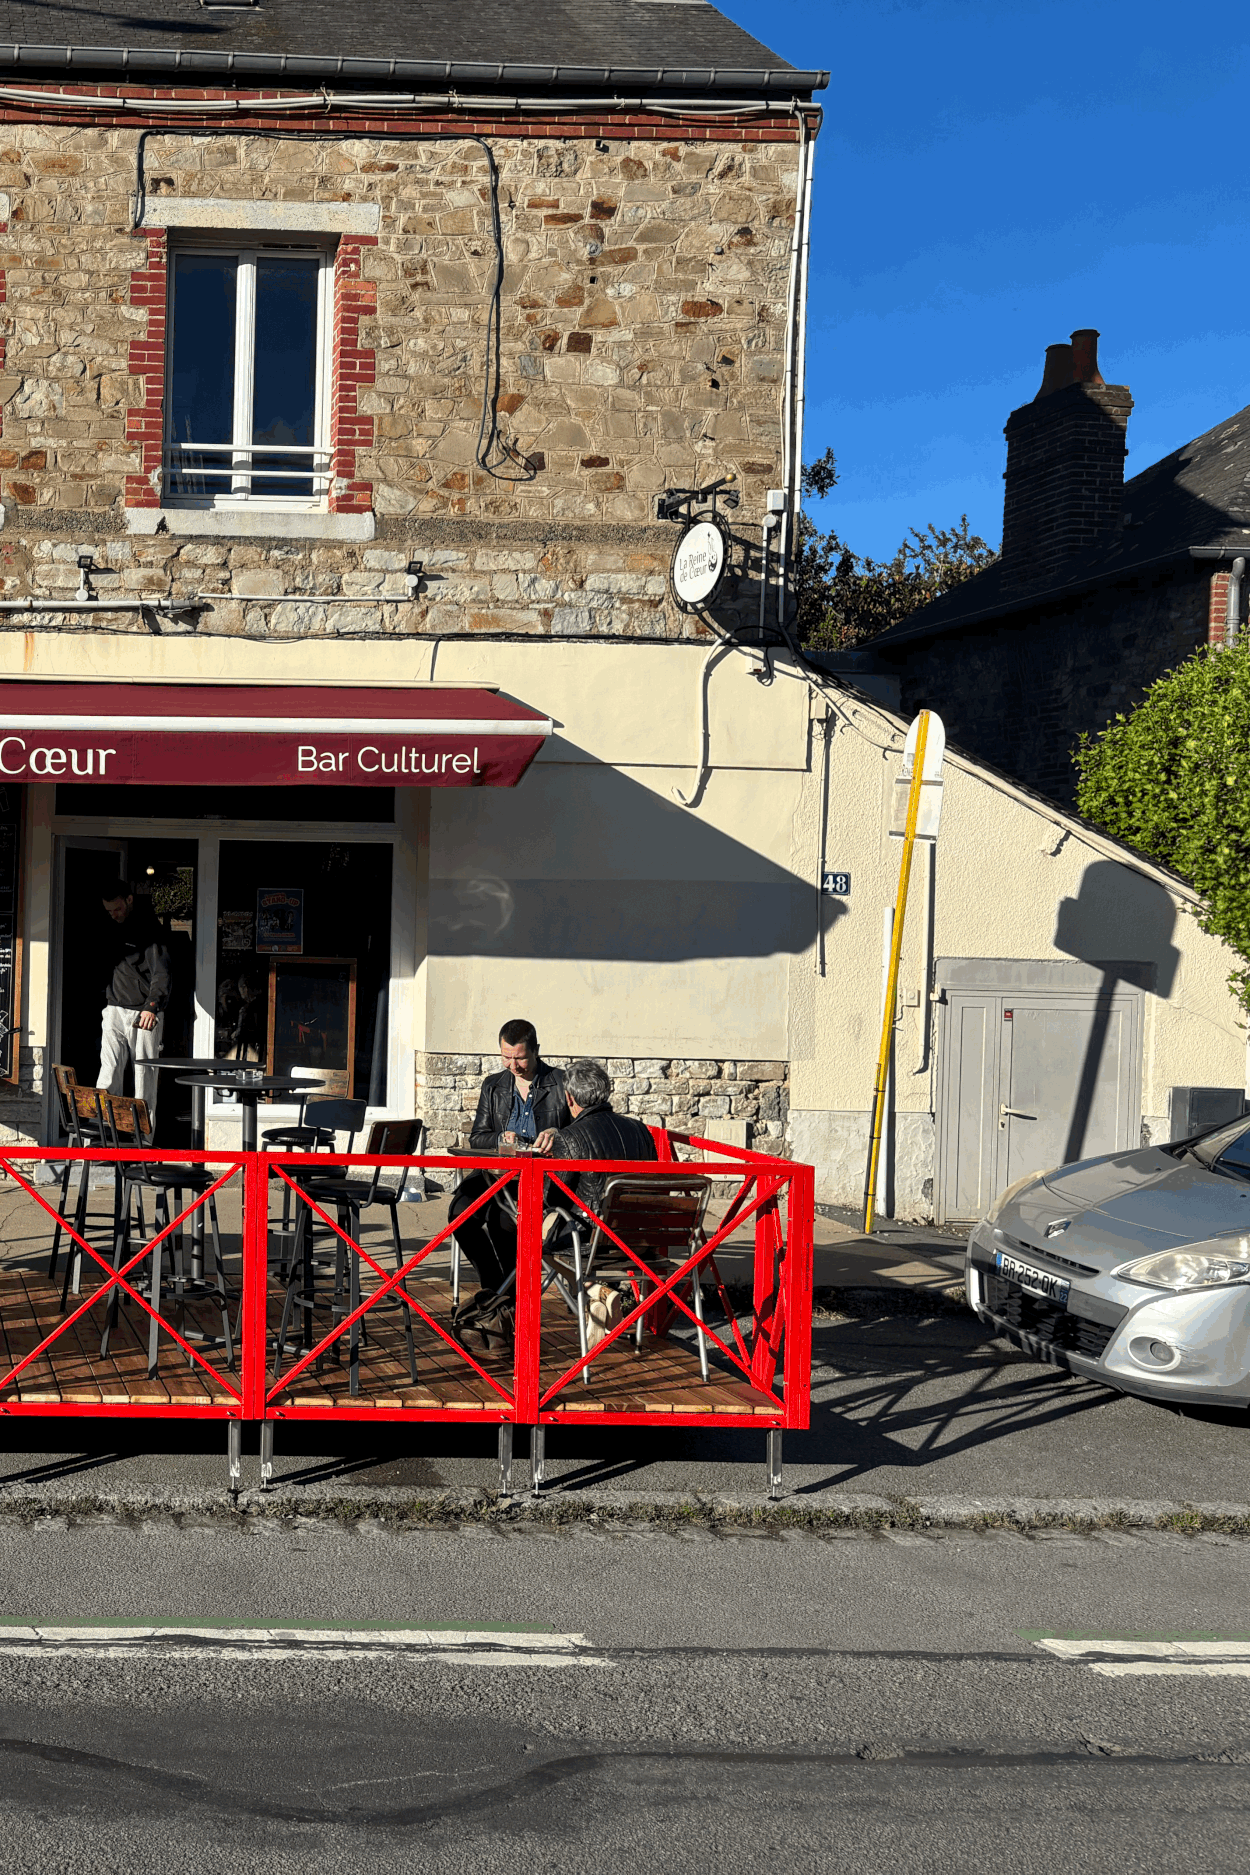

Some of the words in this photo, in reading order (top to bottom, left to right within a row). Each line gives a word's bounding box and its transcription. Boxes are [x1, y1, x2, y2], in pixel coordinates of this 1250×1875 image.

[679, 558, 688, 571] La
[689, 551, 707, 567] Reine
[679, 569, 688, 583] de
[689, 564, 707, 580] Cœur
[297, 746, 349, 772] Bar
[357, 746, 481, 774] Culturel
[823, 874, 847, 893] 48
